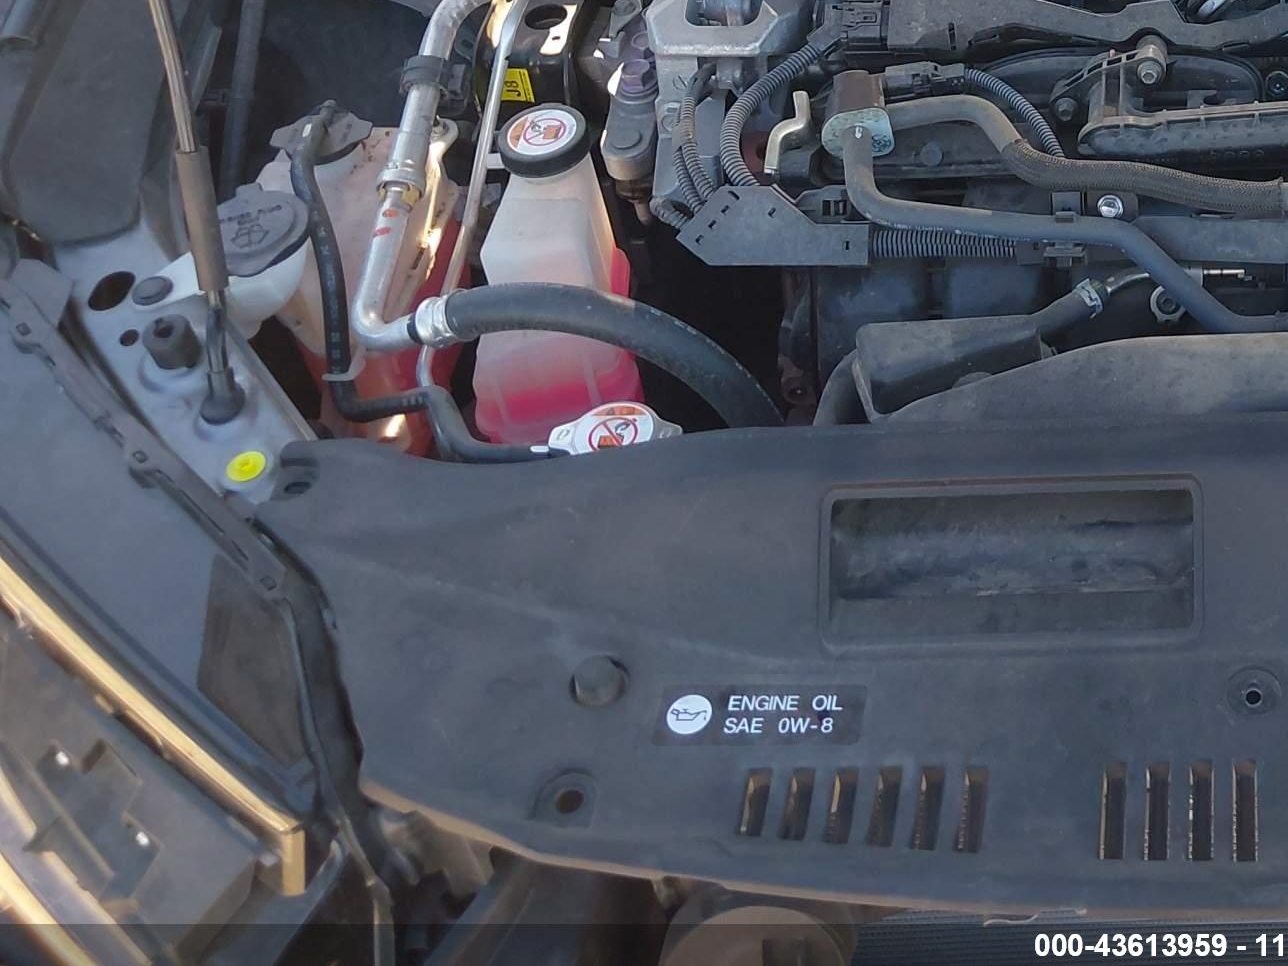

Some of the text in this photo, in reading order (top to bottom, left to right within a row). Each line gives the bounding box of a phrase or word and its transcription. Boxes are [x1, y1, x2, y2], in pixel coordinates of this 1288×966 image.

[728, 695, 843, 711] ENGINE OIL
[723, 717, 834, 734] SAE 0W-8
